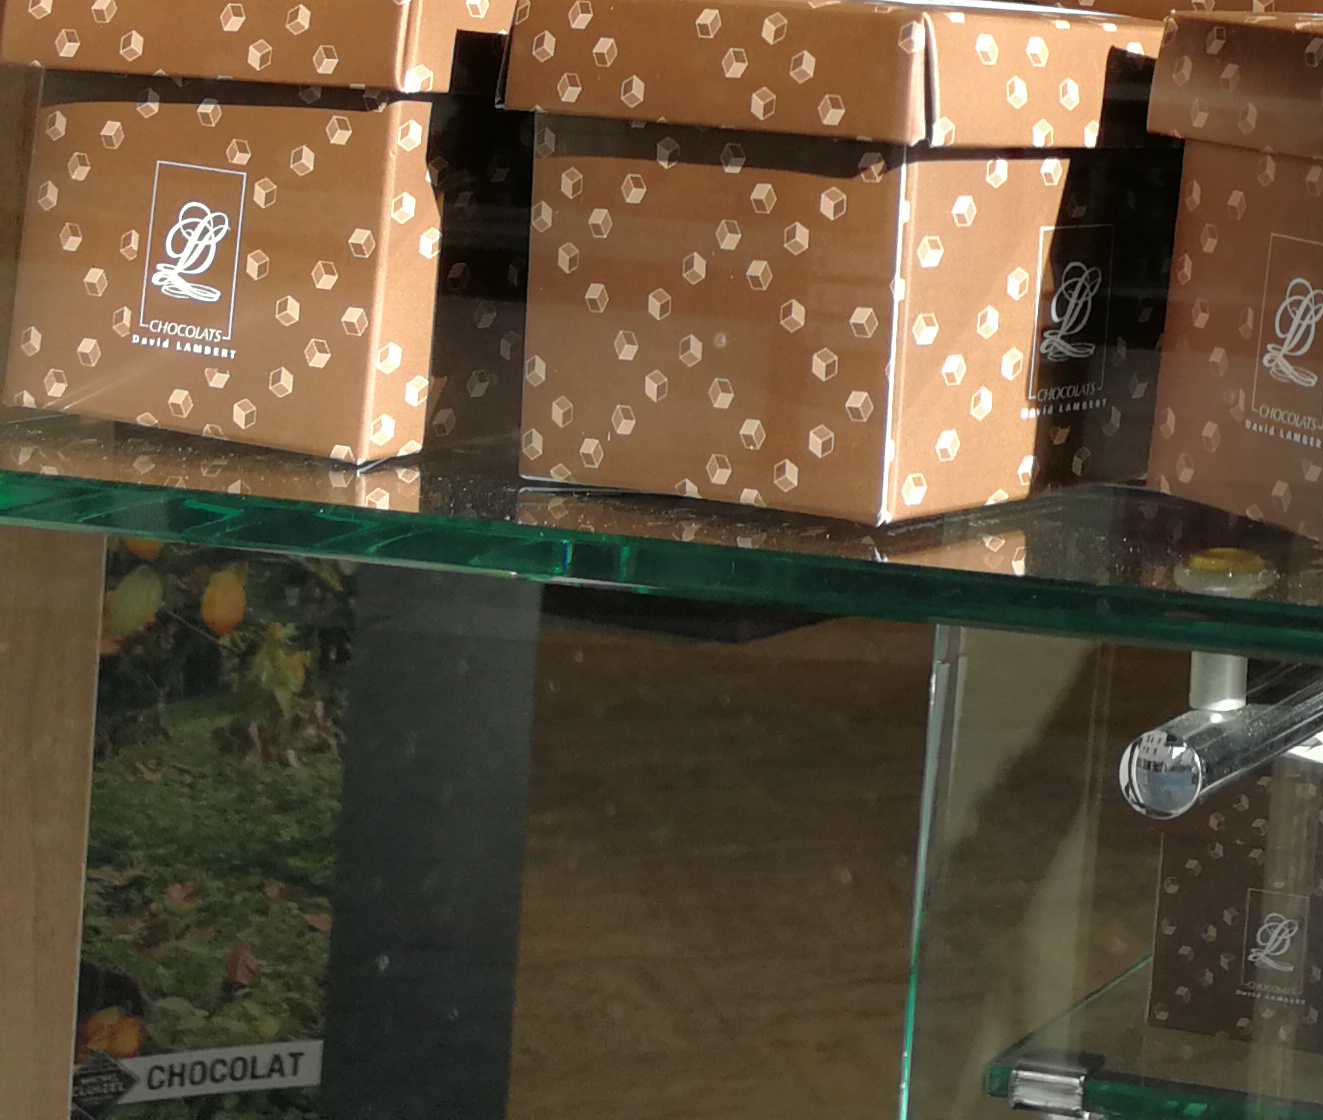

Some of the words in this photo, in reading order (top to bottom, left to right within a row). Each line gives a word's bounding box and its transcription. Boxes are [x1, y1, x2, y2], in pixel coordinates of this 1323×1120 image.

[149, 320, 223, 342] CHOCOLATS
[132, 334, 169, 348] David
[176, 341, 237, 359] LAMBERT
[1037, 382, 1095, 402] CHOCOLATS
[1259, 405, 1317, 430] CHOCOLATS
[148, 1051, 305, 1090] CHOCOLAT
